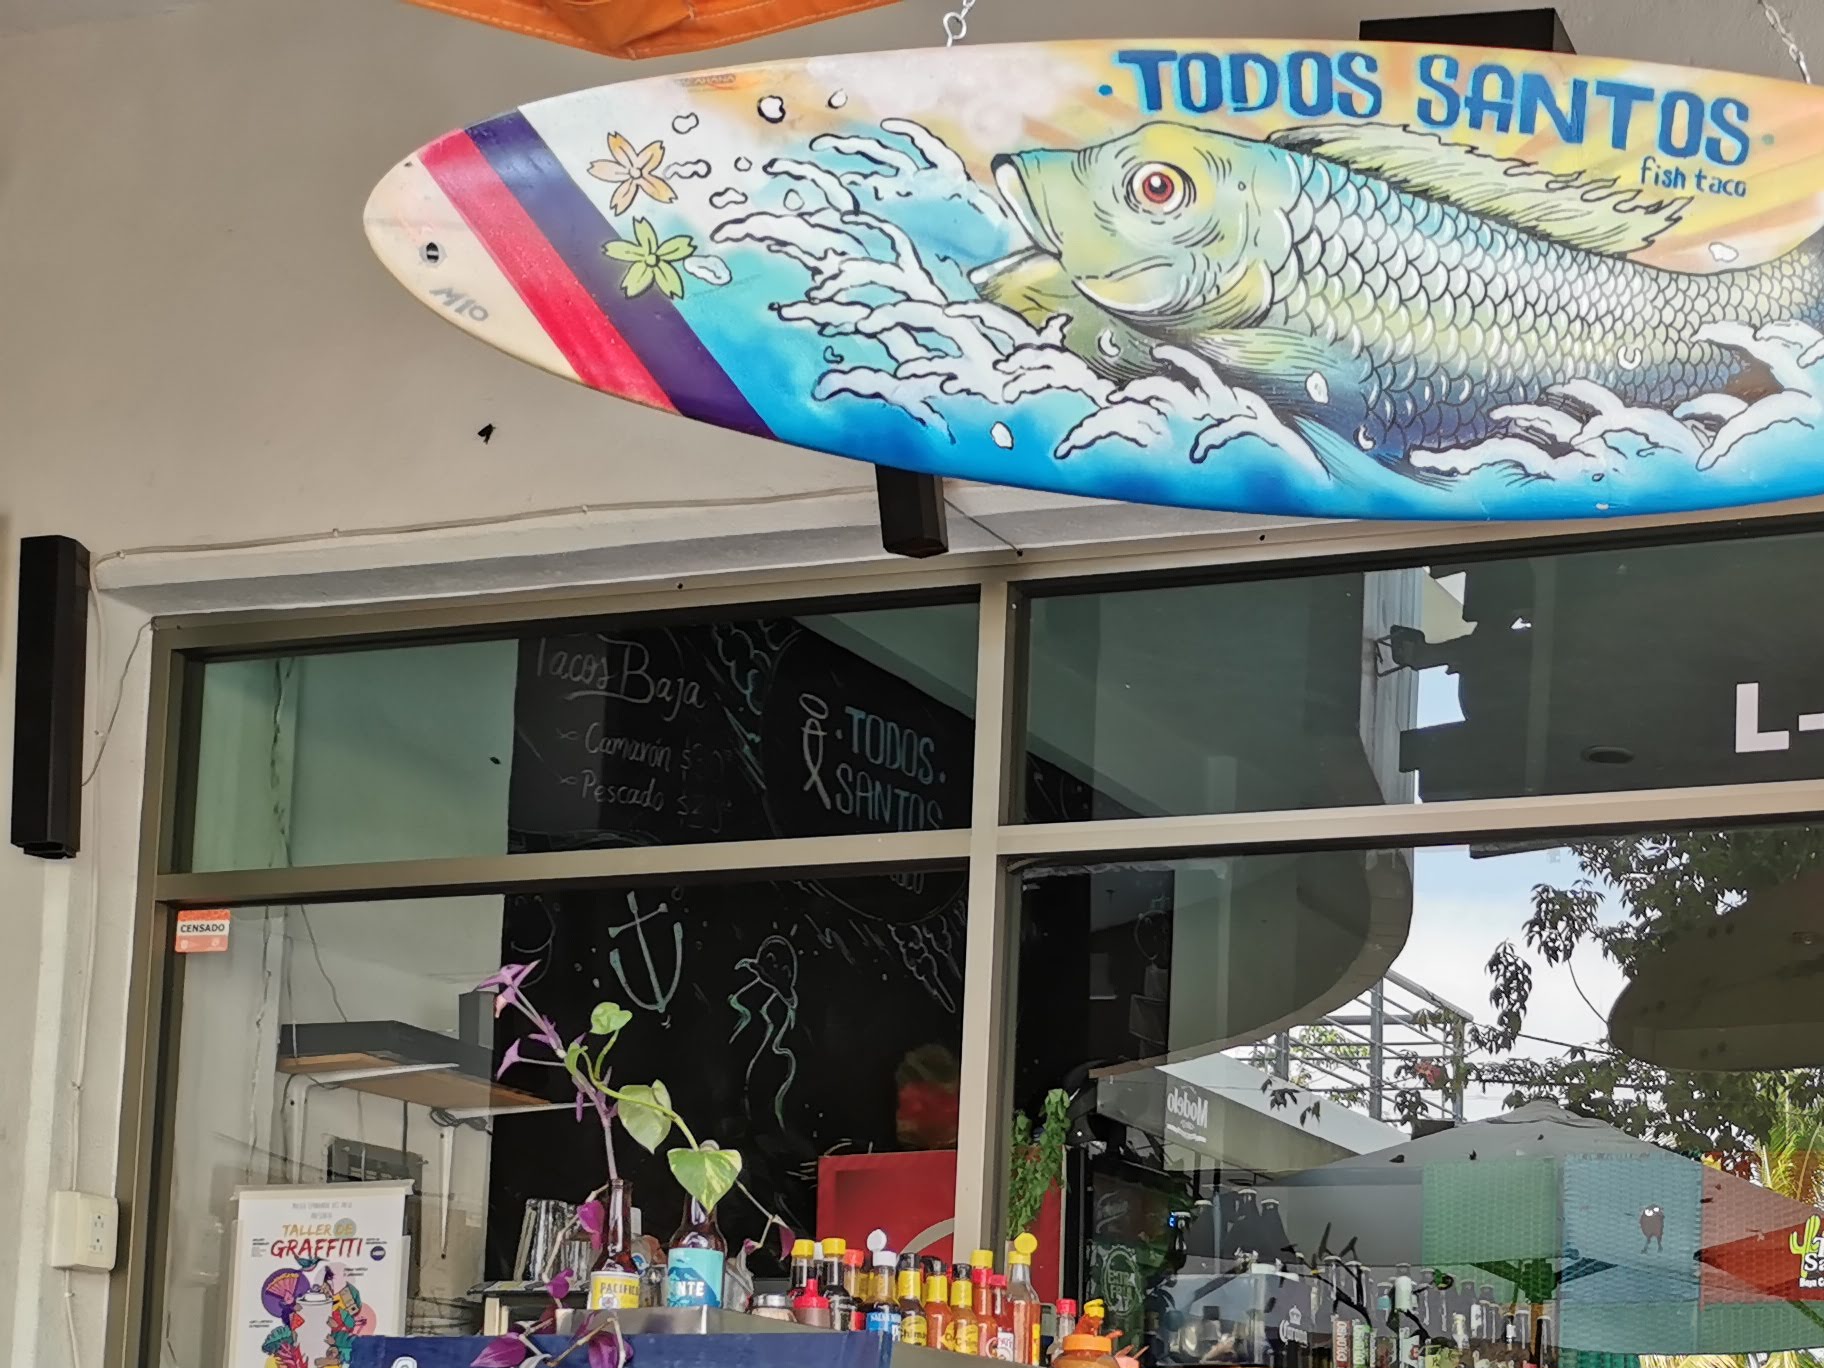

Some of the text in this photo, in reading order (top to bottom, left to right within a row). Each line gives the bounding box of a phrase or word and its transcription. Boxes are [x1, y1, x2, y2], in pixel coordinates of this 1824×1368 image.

[1114, 48, 1752, 166] TODOS SANTOS
[1639, 157, 1748, 198] fish taco
[536, 634, 707, 722] Tacos Baja
[843, 705, 936, 785] TODOS
[580, 769, 666, 813] Pescado
[180, 923, 226, 933] CENSADO
[270, 1237, 364, 1259] GRAFFITI
[282, 1223, 353, 1238] TALLER DE
